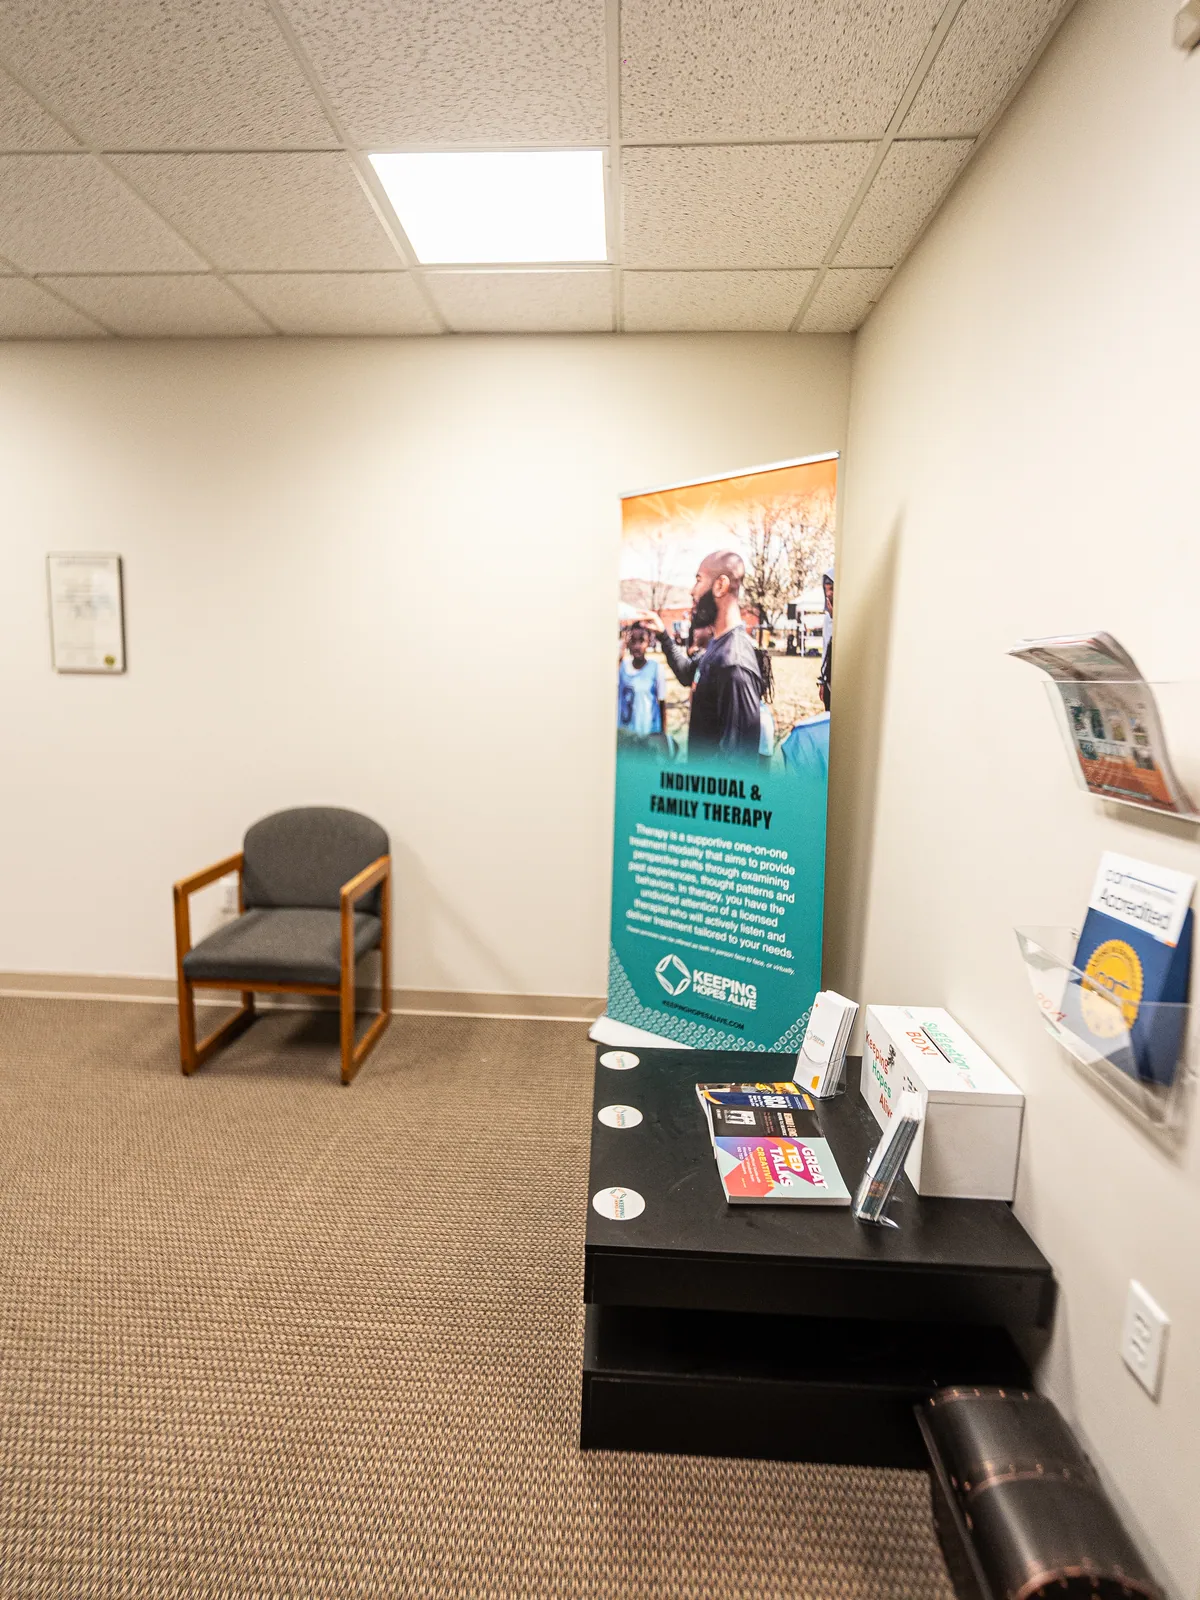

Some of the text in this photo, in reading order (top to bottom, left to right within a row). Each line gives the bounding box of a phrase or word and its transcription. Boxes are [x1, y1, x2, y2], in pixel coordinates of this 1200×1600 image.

[661, 771, 762, 802] INDIVIDUAL &
[650, 794, 773, 830] FAMILY THERAPY
[628, 836, 796, 876] treatment modality that aims to provide
[635, 823, 788, 860] Therapy is a supportive one-on-one
[700, 875, 735, 890] thought
[736, 883, 774, 899] patterns
[776, 892, 795, 904] and
[704, 863, 740, 879] through
[741, 871, 790, 890] examining
[680, 898, 719, 913] attention
[720, 906, 730, 916] of
[731, 909, 738, 918] a
[739, 910, 779, 928] licensed
[688, 885, 723, 903] therapy,
[725, 894, 743, 906] you
[744, 897, 768, 911] have
[769, 903, 786, 916] the
[1099, 887, 1171, 930] Accredited
[653, 916, 693, 934] treatment
[693, 925, 728, 942] tailored
[728, 934, 738, 945] to
[740, 938, 761, 950] your
[762, 943, 795, 960] needs.
[704, 916, 739, 933] actively
[740, 922, 766, 938] listen
[767, 930, 786, 943] and
[715, 949, 734, 959] person
[752, 958, 765, 967] face,
[692, 969, 757, 1000] KEEPING
[692, 983, 727, 1001] HOPES
[727, 993, 757, 1011] ALIVE
[865, 1030, 889, 1075] Keeping
[905, 1031, 939, 1056] BOX!
[922, 1021, 970, 1070] Suggestion
[872, 1060, 892, 1098] Hopes
[756, 1146, 775, 1189] CREATIVITY
[769, 1146, 794, 1188] TALKS
[785, 1146, 805, 1172] TED
[801, 1147, 828, 1189] GREAT
